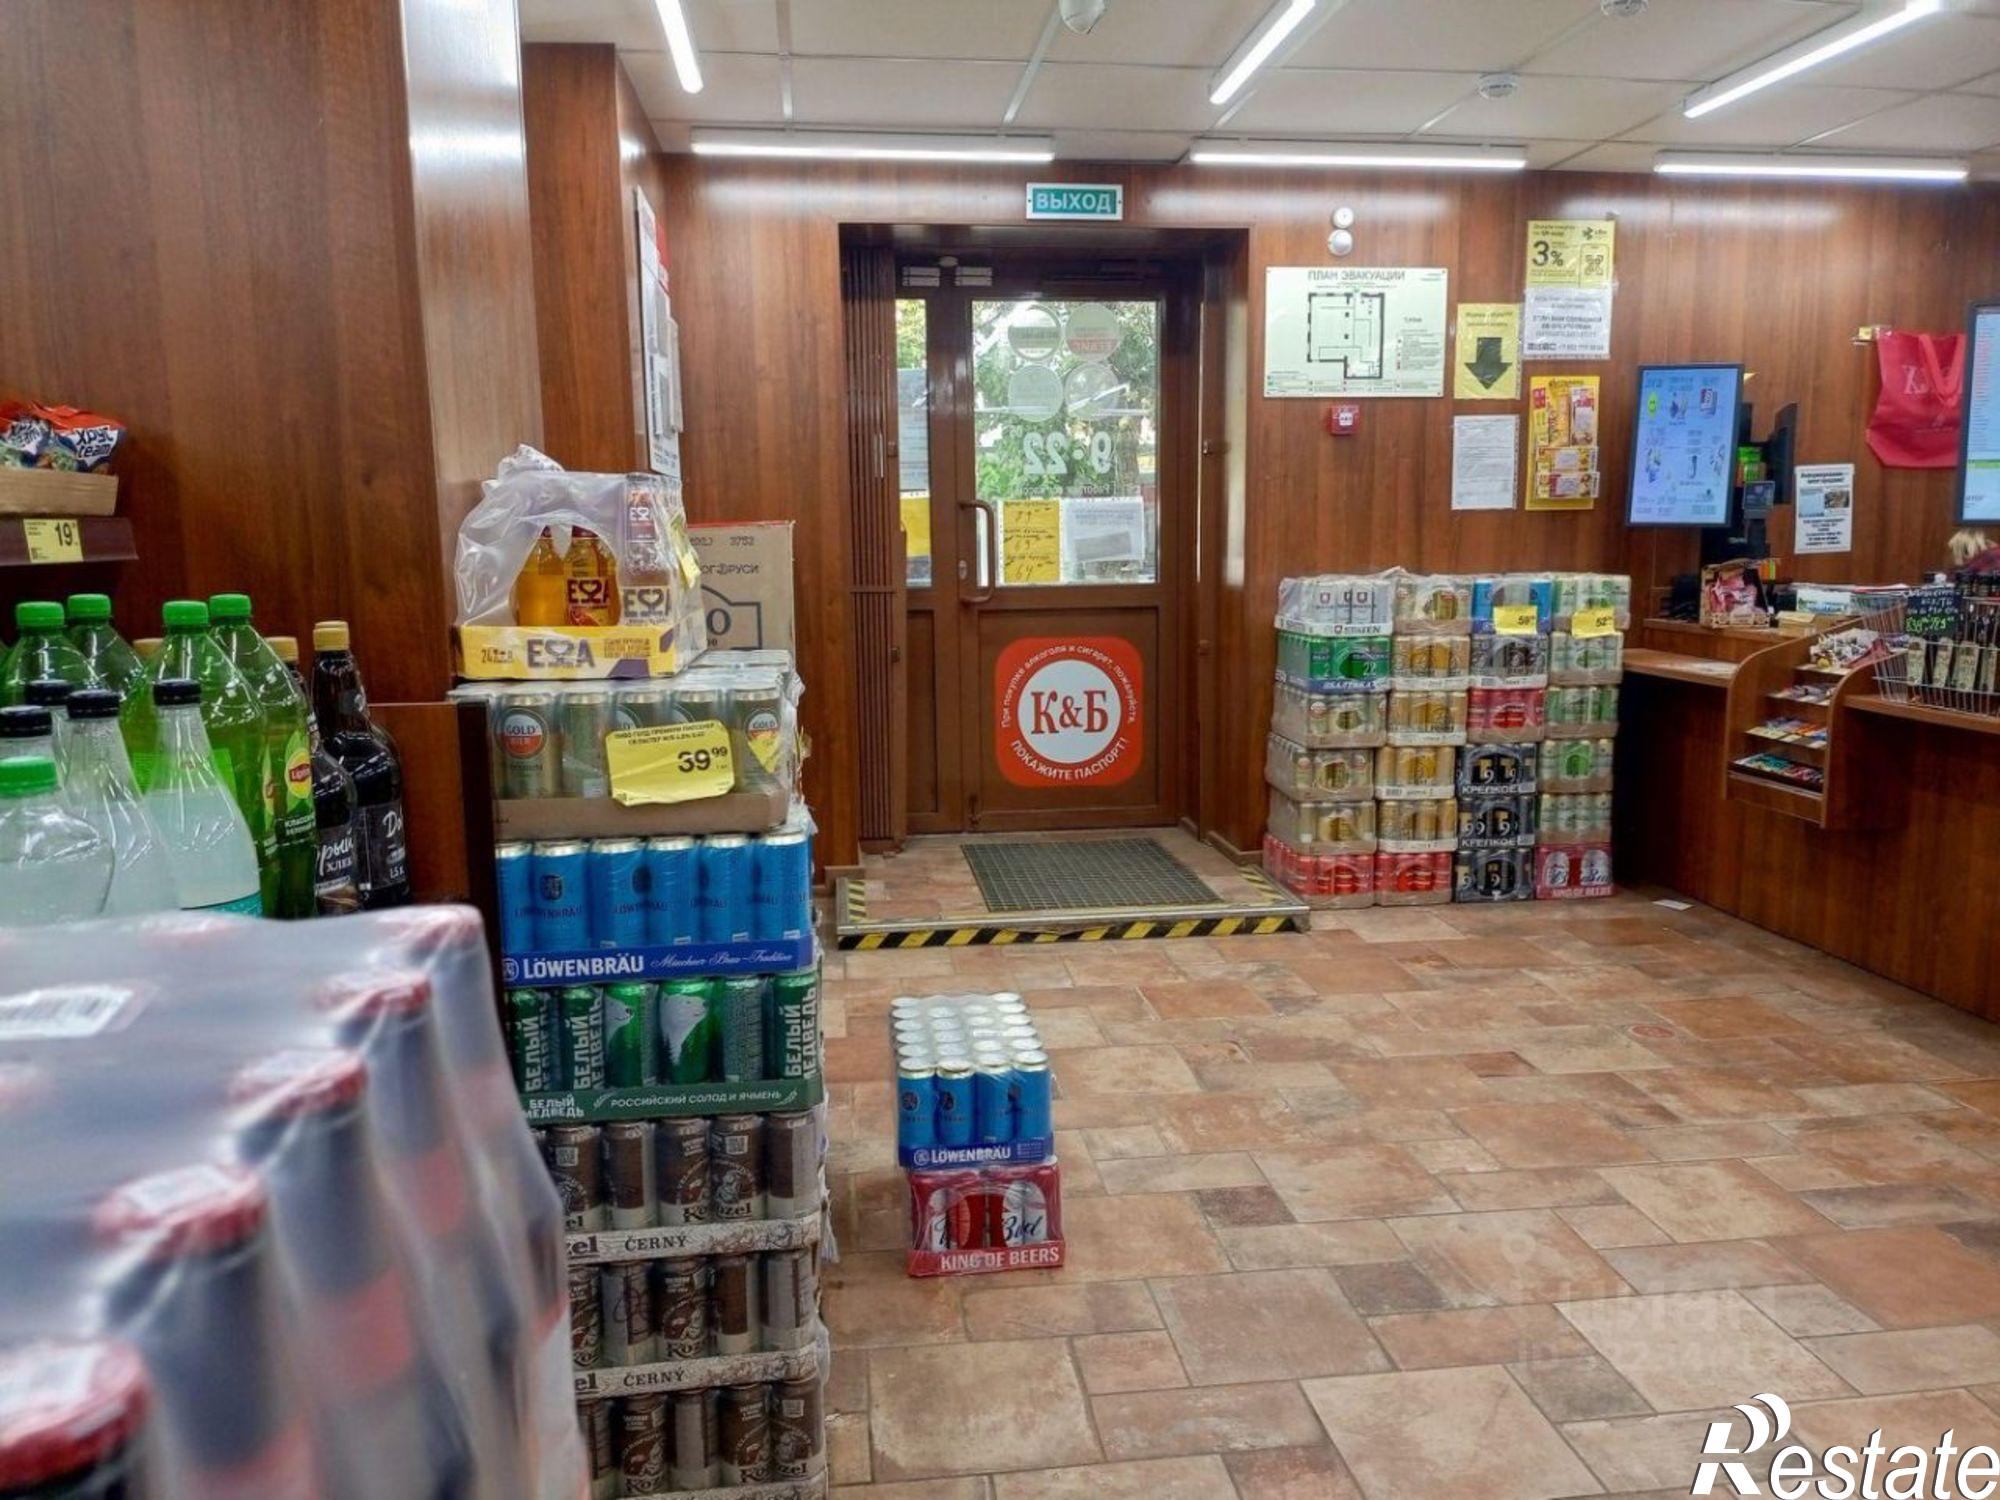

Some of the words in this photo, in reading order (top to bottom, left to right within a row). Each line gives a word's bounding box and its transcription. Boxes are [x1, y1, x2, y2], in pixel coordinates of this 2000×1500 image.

[1036, 192, 1111, 213] ВЫХОД
[1307, 269, 1338, 281] ПЛАН
[1341, 269, 1406, 282] ЭВАКУАЦИИ
[55, 522, 73, 547] 19
[1004, 667, 1026, 708] покупке
[1024, 645, 1068, 669] алкоголя
[1030, 689, 1110, 735] К&Б
[677, 749, 711, 773] 39
[1010, 738, 1073, 782] ПОКАЖИТЕ
[1073, 736, 1128, 781] ПАСПОРТ!
[523, 952, 645, 979] LÖWENBRÄU
[564, 1015, 592, 1090] БЕЛЫЙ
[778, 1004, 802, 1077] БЕЛЫЙ
[515, 1016, 542, 1092] БЕЛЫЙ
[529, 1093, 575, 1109] БЕЛЫЙ
[611, 1095, 687, 1108] РОССИЙСКИЙ
[688, 1092, 728, 1104] СОЛОД
[728, 1092, 737, 1101] И
[739, 1090, 782, 1101] ЯЧМЕНЬ
[624, 1232, 688, 1251] ČERNÝ
[940, 1253, 980, 1270] KING
[984, 1252, 1005, 1267] OF
[1009, 1246, 1060, 1265] BEERS
[623, 1366, 687, 1388] ČERNÝ
